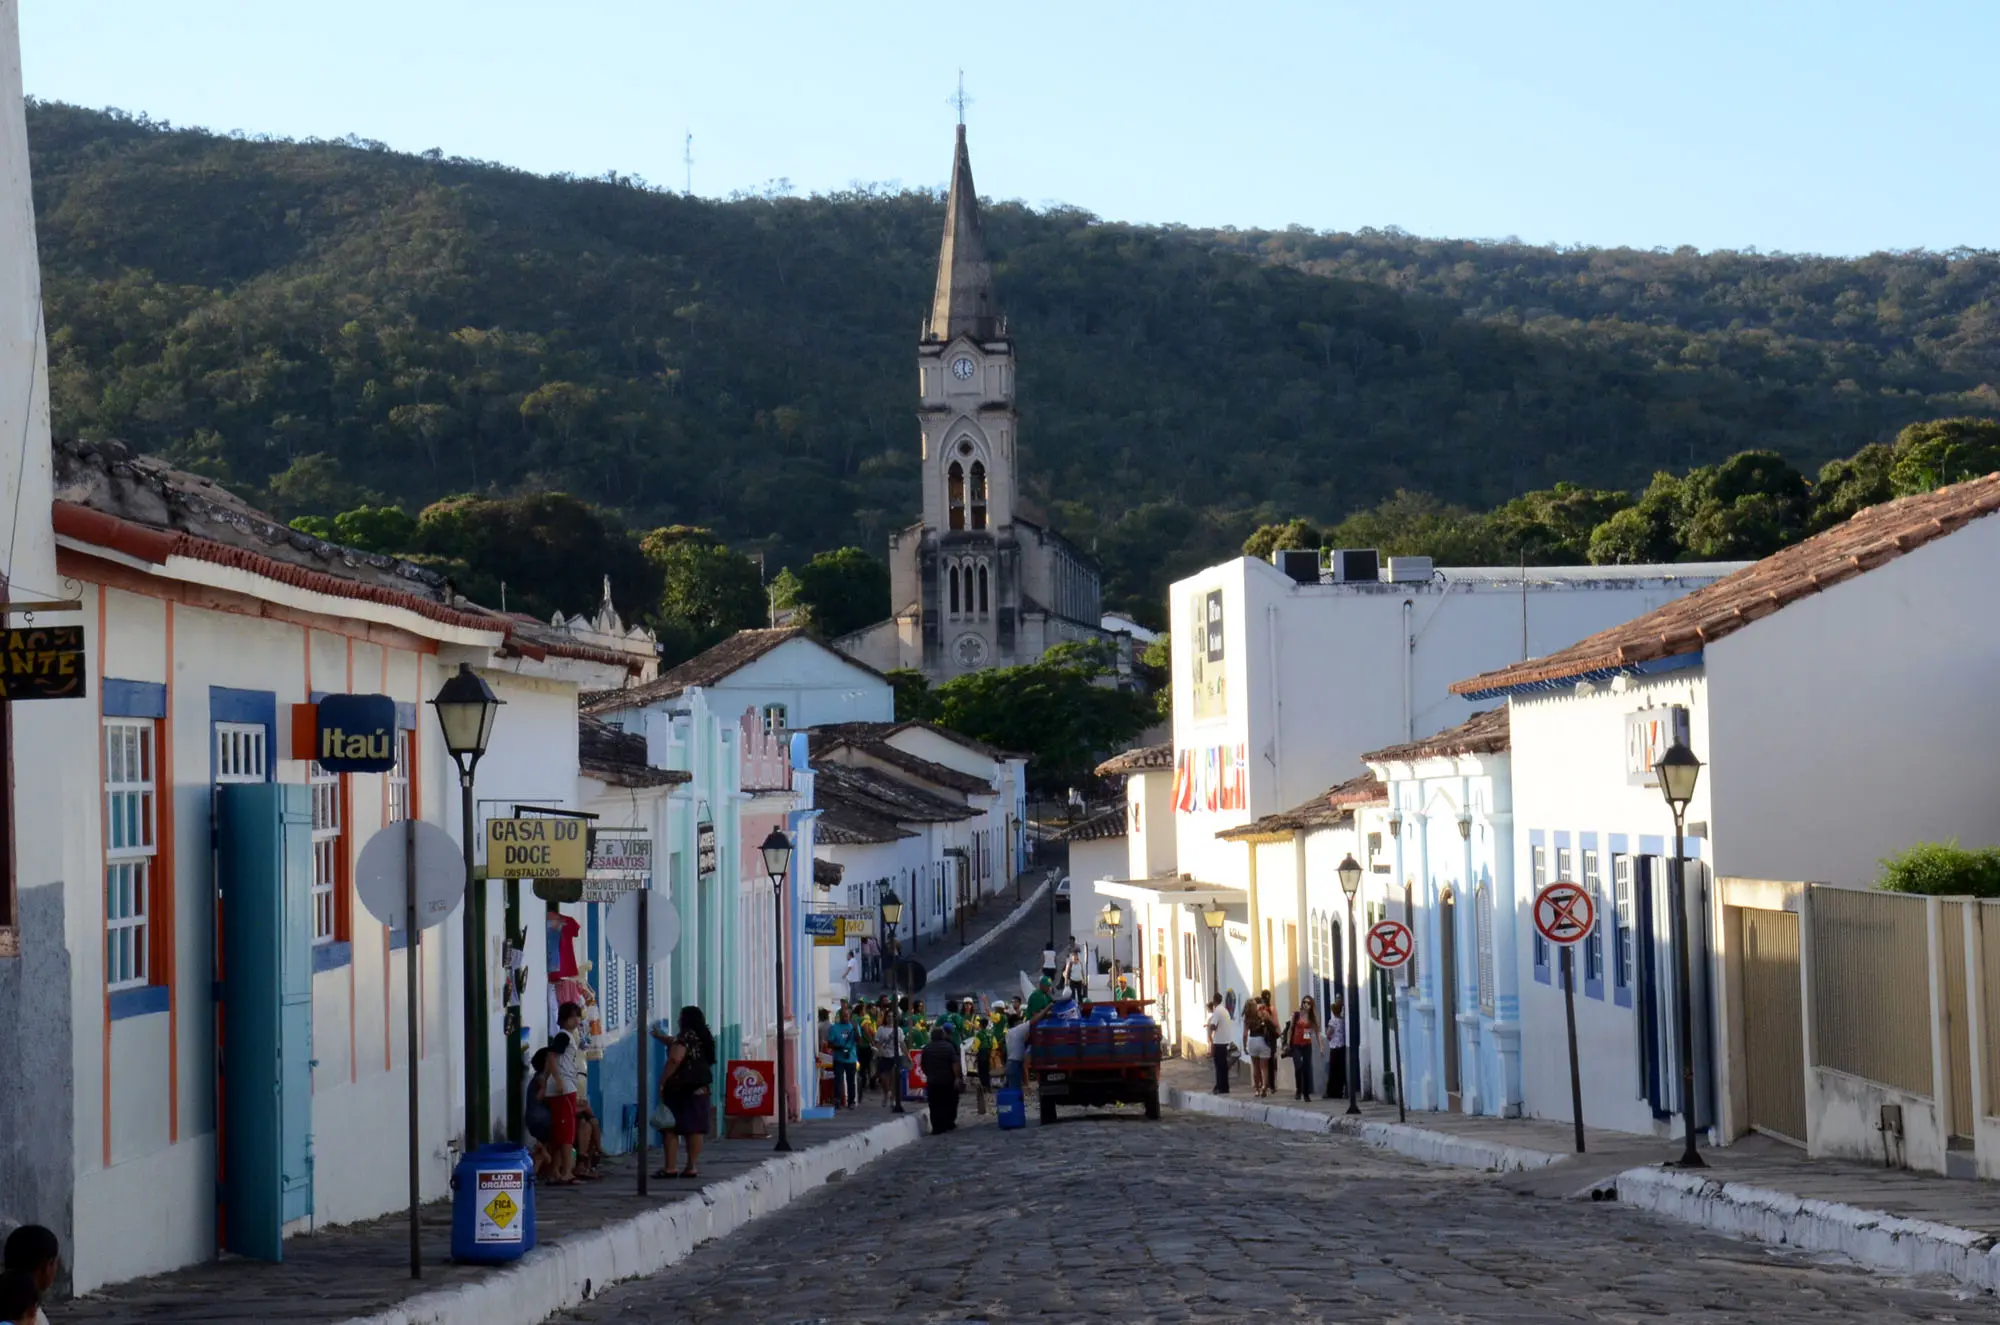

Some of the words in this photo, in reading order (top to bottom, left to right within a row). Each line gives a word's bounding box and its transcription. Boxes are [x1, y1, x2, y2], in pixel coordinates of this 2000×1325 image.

[322, 727, 390, 759] Itaú
[491, 821, 546, 841] CASA
[554, 821, 579, 841] DO
[505, 845, 551, 865] DOCE
[620, 840, 649, 856] VIDA
[503, 868, 561, 877] CRISTALIZADO
[481, 1181, 522, 1189] ORGÂNICO
[494, 1200, 512, 1209] FICA
